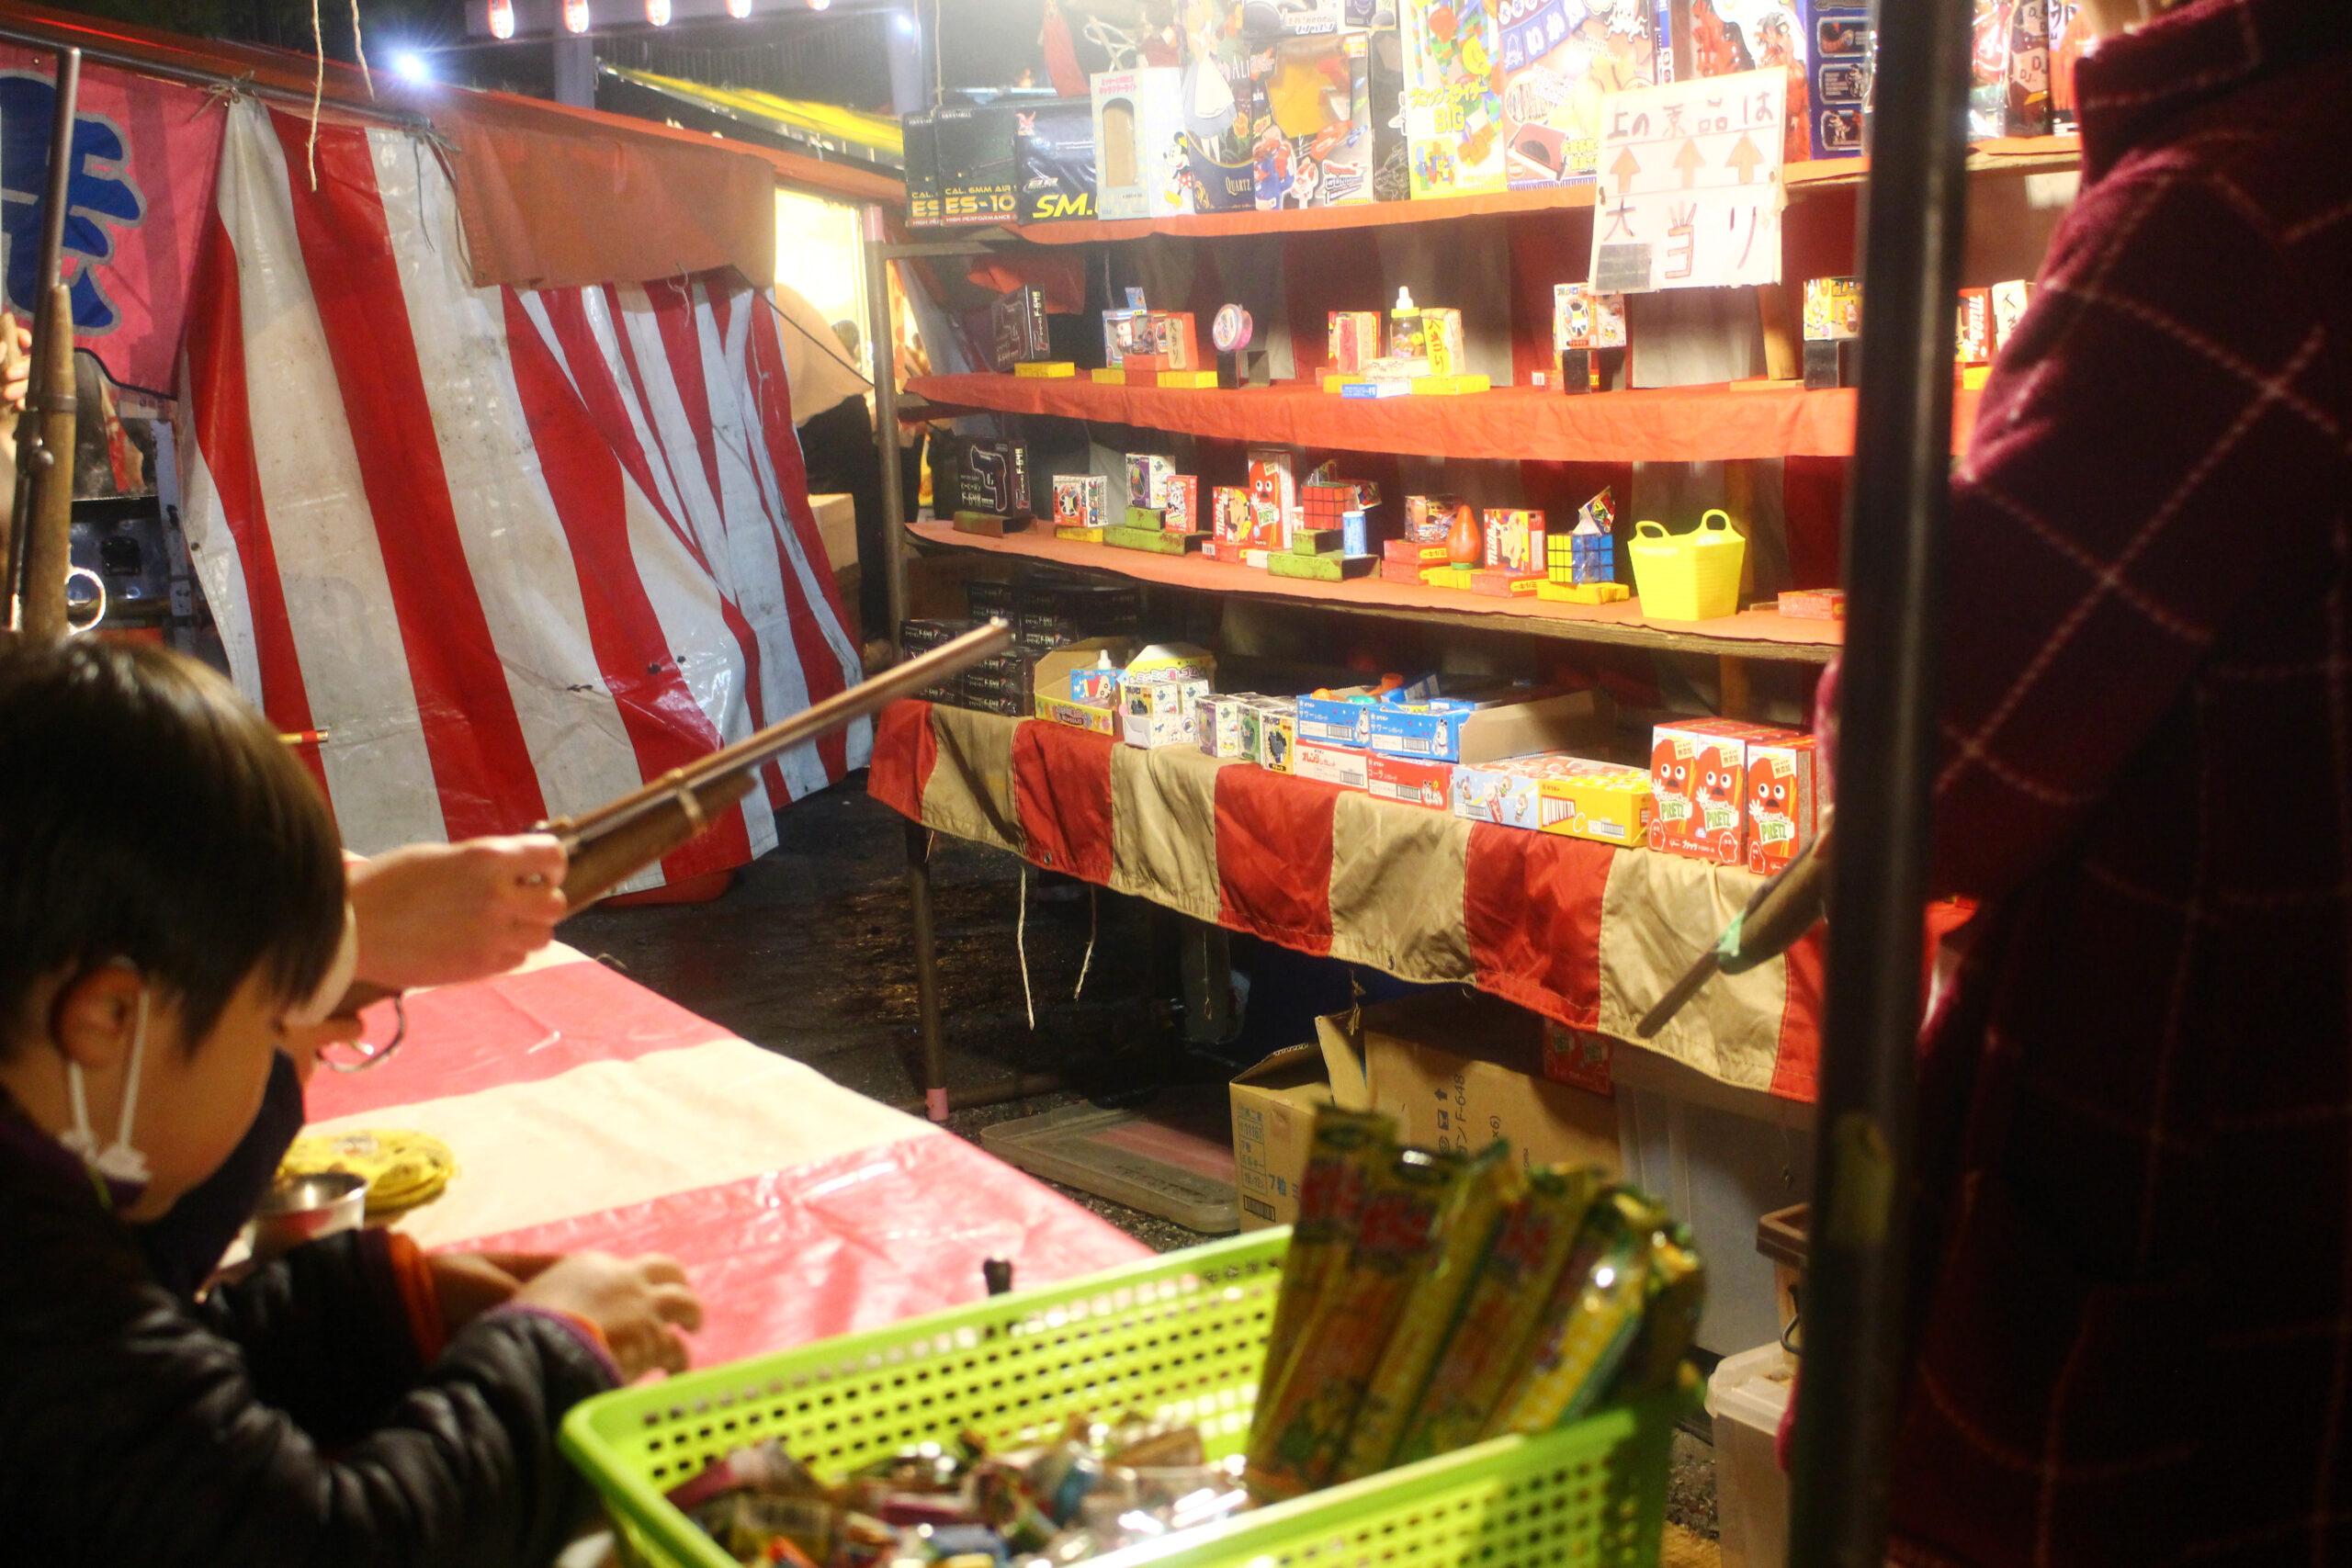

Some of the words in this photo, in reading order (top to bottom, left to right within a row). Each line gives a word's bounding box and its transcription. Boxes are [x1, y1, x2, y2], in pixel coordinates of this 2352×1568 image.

[1434, 105, 1465, 133] BIG
[944, 187, 966, 196] CAL.
[994, 185, 1012, 193] AIR
[1032, 192, 1099, 219] SM.
[962, 214, 1011, 222] PERFORMANCE
[1487, 517, 1501, 567] Milky
[1542, 795, 1576, 827] MINIVITA
[1572, 812, 1587, 833] C
[1661, 802, 1685, 820] PRETZ
[1706, 810, 1731, 829] PRETZ
[1761, 823, 1787, 842] PRETZ
[1453, 1073, 1467, 1122] F-648
